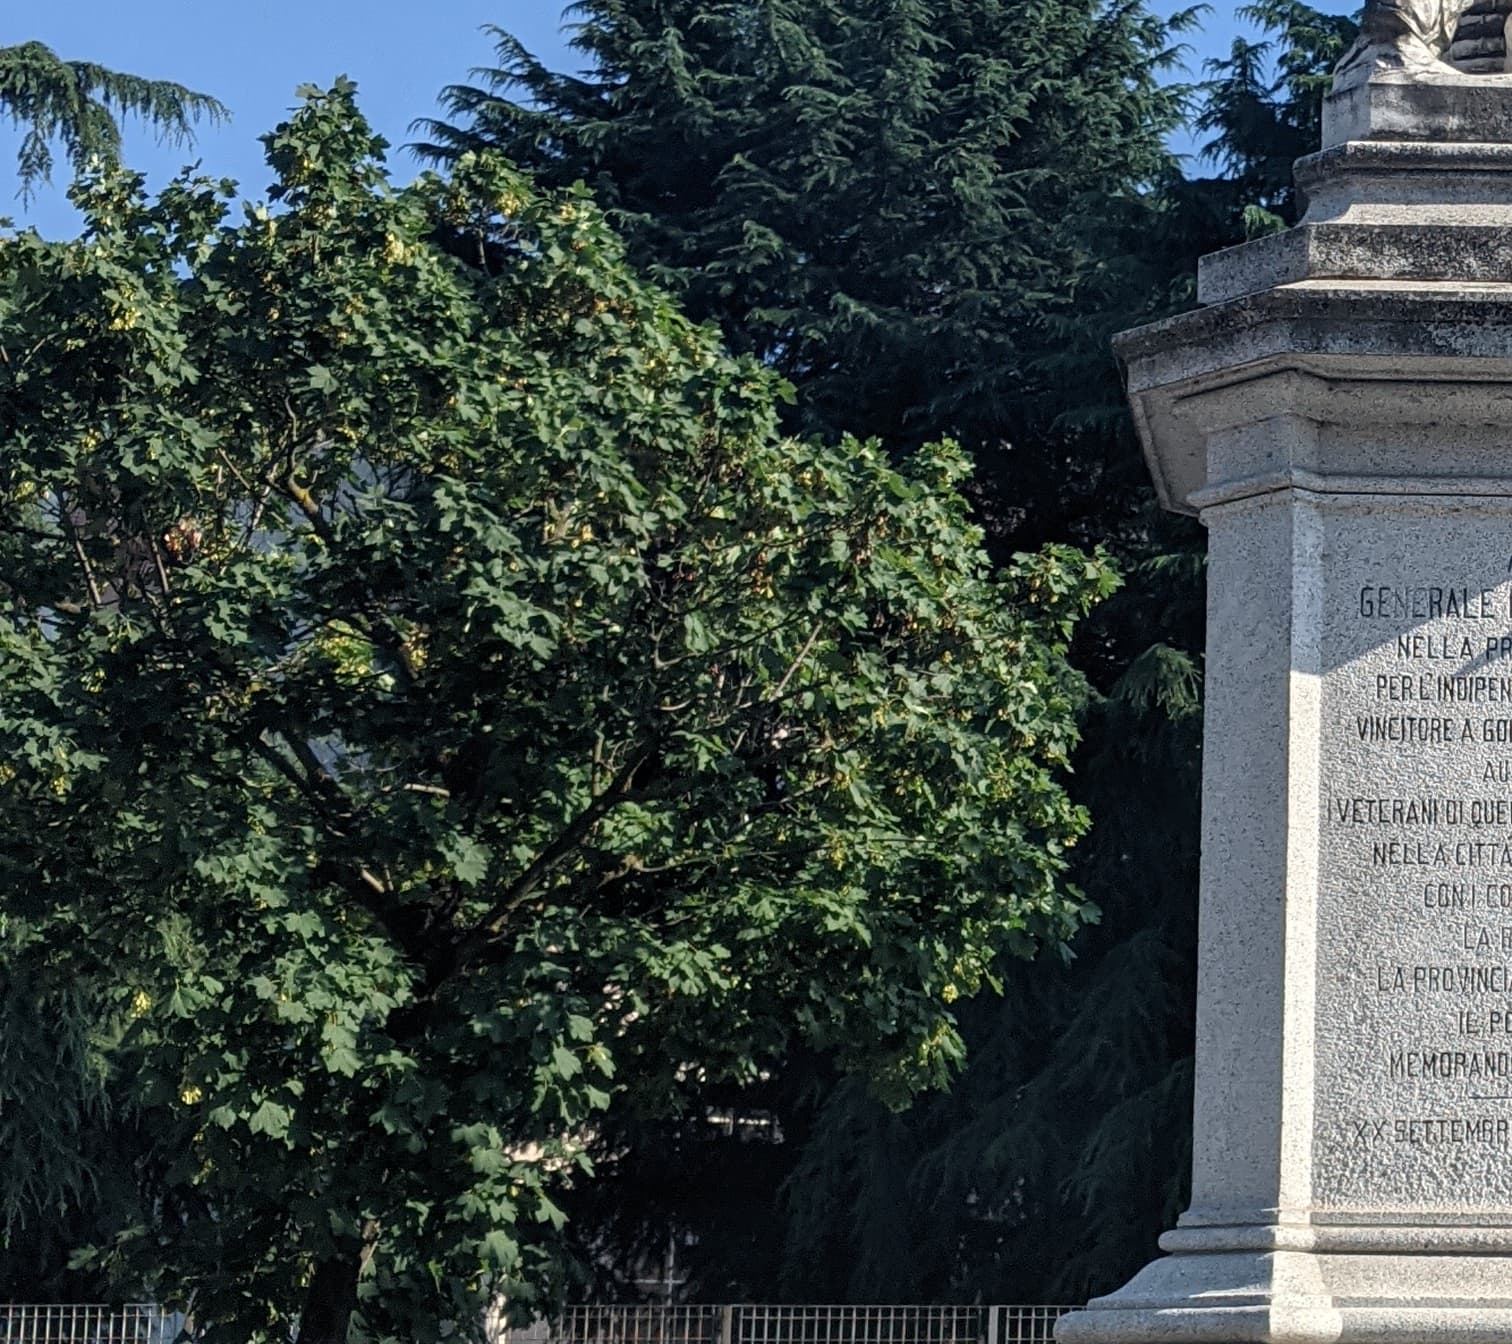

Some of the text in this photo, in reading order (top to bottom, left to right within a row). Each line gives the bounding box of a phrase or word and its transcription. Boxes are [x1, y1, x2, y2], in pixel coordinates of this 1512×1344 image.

[1360, 586, 1496, 620] GENERALE
[1398, 636, 1474, 660] NELLA
[1376, 674, 1414, 702] PER
[1356, 716, 1453, 743] VINCITORE
[1461, 718, 1475, 743] A
[1336, 798, 1439, 825] VETERANI
[1446, 800, 1463, 825] DI
[1373, 842, 1448, 866] NELLA
[1424, 884, 1463, 908] CON
[1463, 926, 1491, 950] LA
[1377, 967, 1406, 993] LA
[1459, 1011, 1477, 1034] IL
